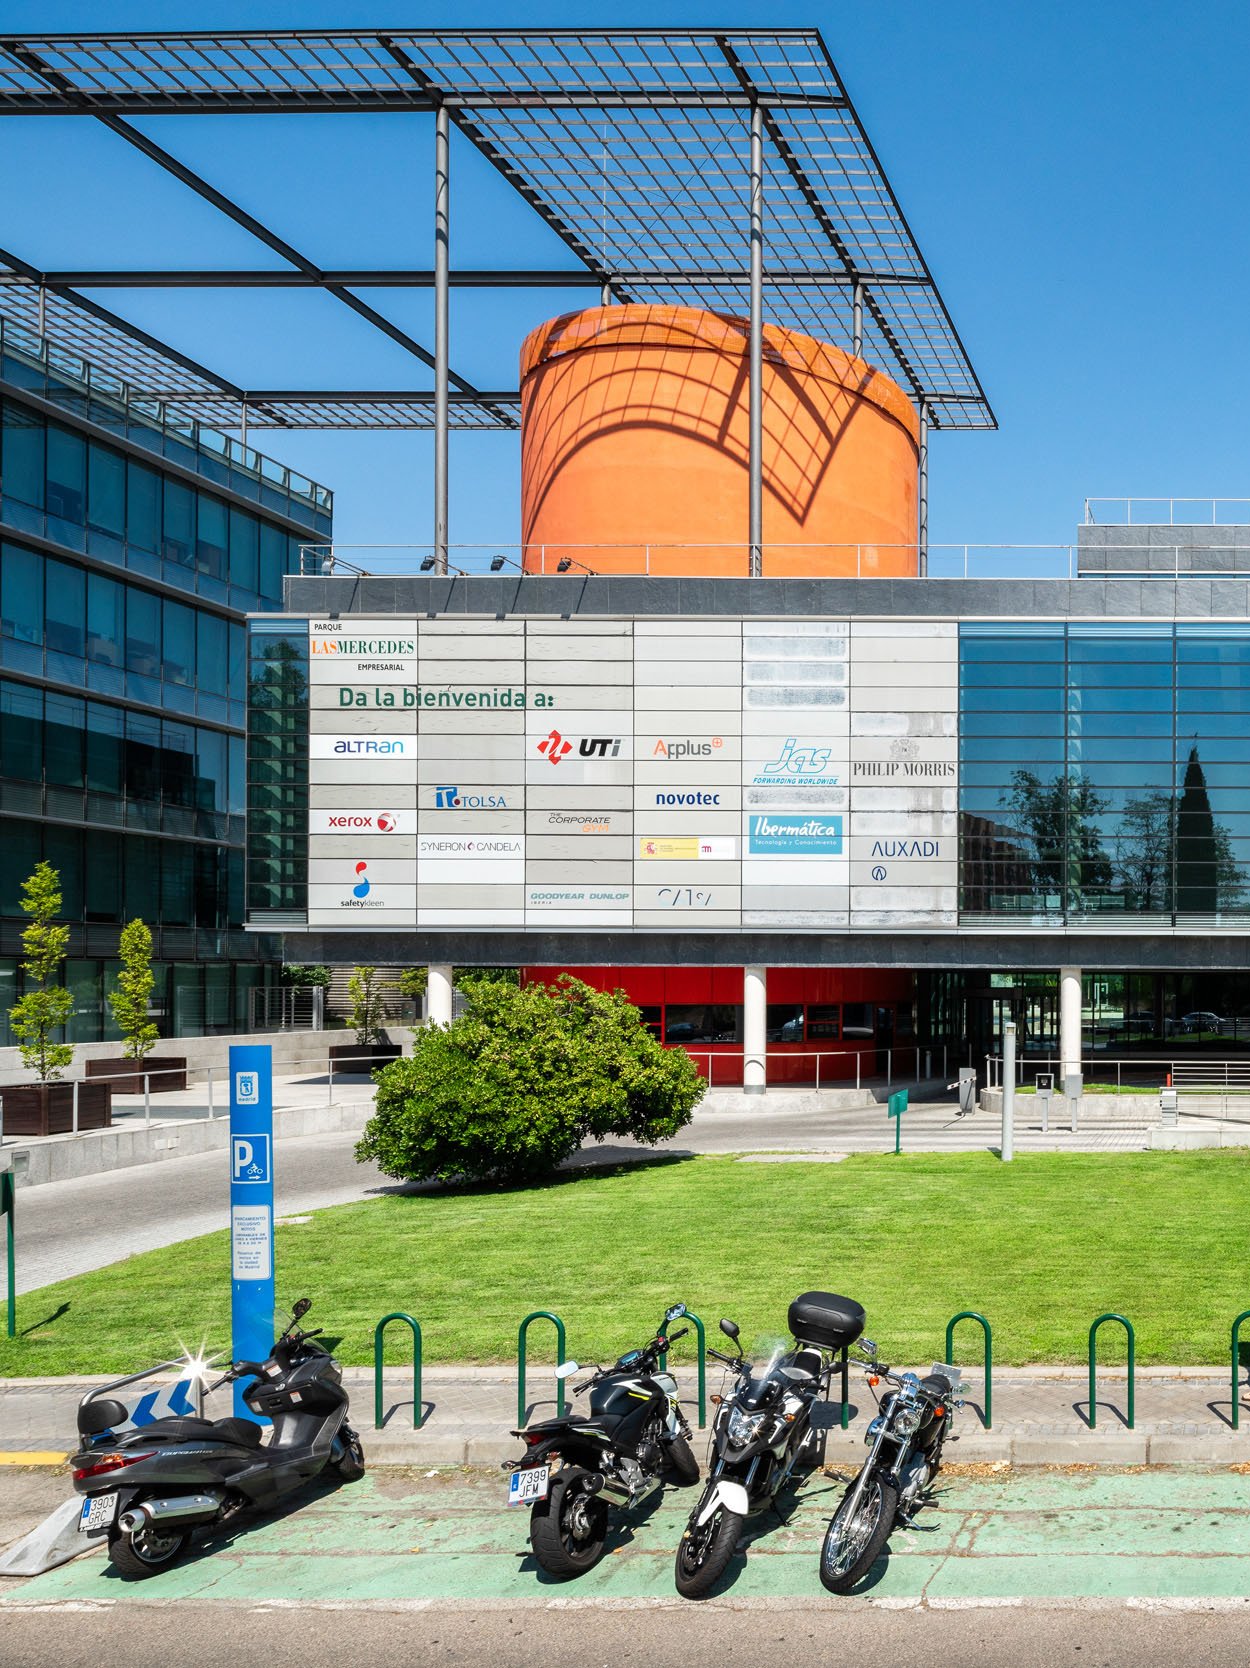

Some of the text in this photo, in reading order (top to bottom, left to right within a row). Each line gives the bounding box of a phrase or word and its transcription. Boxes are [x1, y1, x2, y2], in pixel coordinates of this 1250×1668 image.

[314, 623, 343, 632] PARQUE
[357, 663, 405, 671] EMPRESARIAL
[339, 687, 555, 707] Da la bienvenida a:
[853, 762, 955, 777] PHILIP MORRIS
[752, 777, 839, 785] FORWARDING WORLDWIDE
[460, 795, 507, 808] TOLSA
[655, 791, 721, 806] novotec
[328, 816, 373, 827] xerox
[548, 816, 611, 824] CORPORATE
[582, 824, 610, 833] GYM
[754, 816, 835, 838] Ibermática
[420, 841, 521, 852] SYNERON CANDELA
[871, 840, 939, 857] AUXADI
[530, 892, 630, 900] GOODYEAR DUNLOP
[340, 898, 385, 908] safetykleen
[234, 1140, 253, 1178] P
[520, 1469, 546, 1485] 7399
[519, 1483, 539, 1497] JFM
[91, 1496, 115, 1511] 3903
[88, 1509, 107, 1524] GRC
